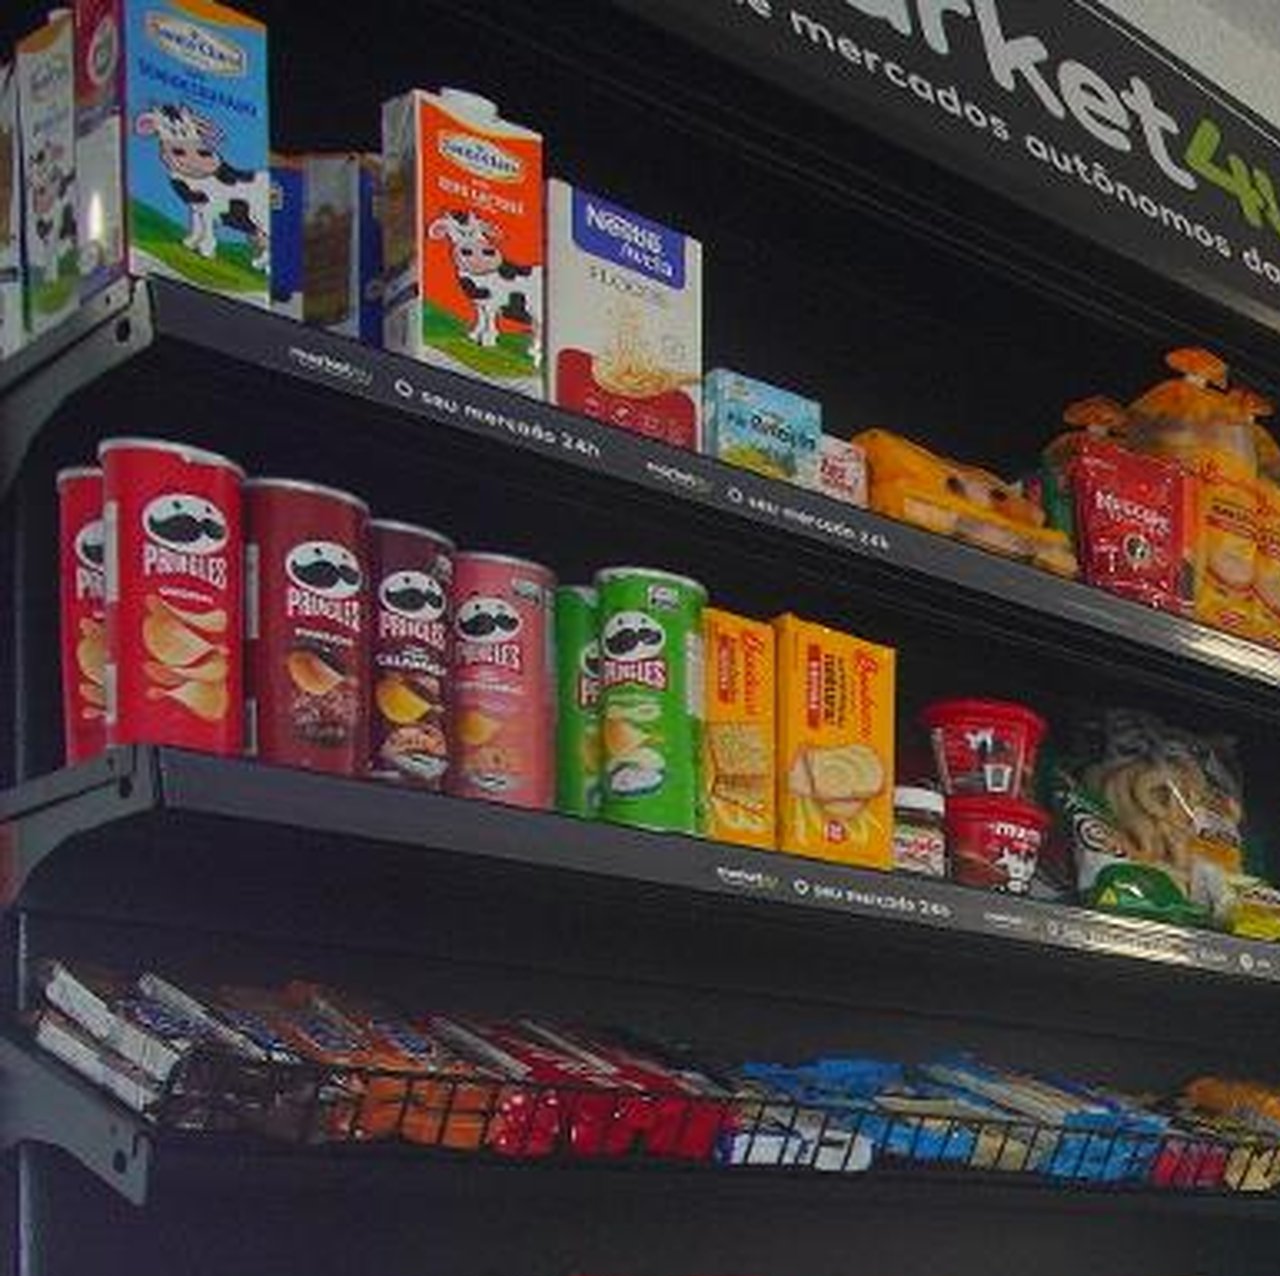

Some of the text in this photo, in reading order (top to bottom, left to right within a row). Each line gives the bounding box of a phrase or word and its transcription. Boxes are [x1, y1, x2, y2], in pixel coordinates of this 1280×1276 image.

[790, 10, 1011, 141] mercados
[1025, 135, 1232, 258] autônomos
[421, 391, 458, 414] seu
[463, 404, 556, 443] mercado
[143, 543, 229, 590] PRINGLES
